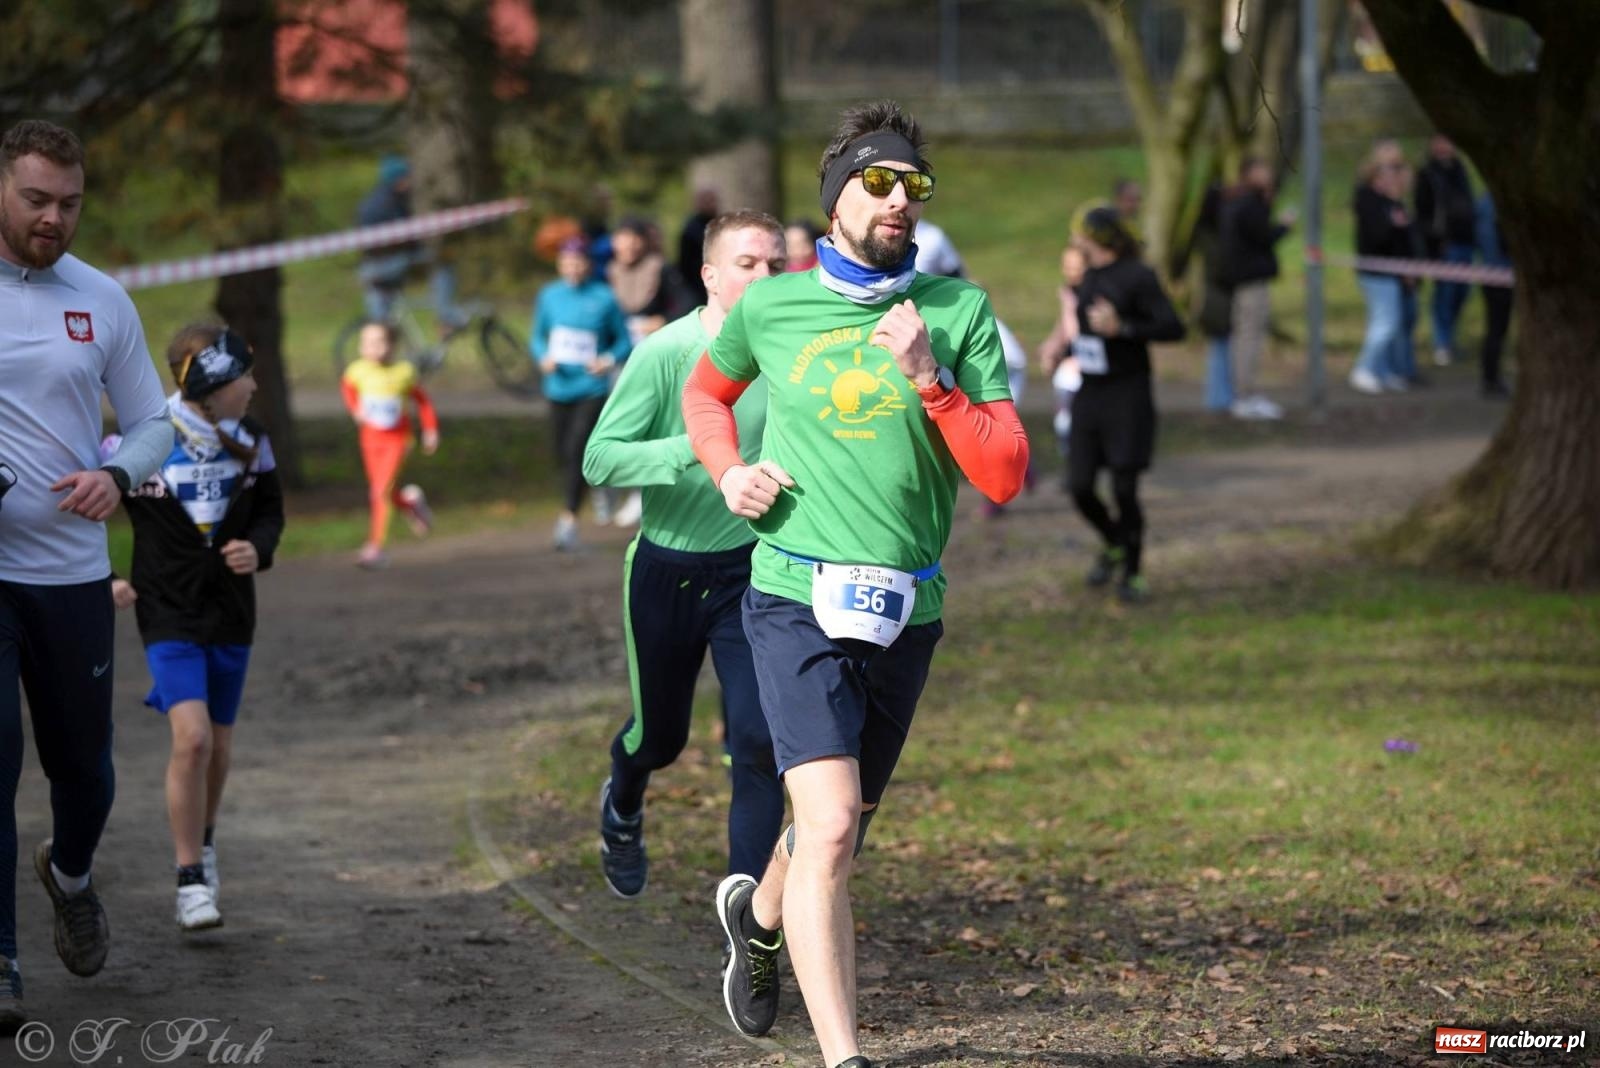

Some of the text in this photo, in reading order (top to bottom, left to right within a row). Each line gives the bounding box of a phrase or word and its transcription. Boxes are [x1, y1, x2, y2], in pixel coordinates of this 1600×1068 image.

[788, 327, 862, 384] NADMORSKA
[197, 482, 222, 501] 58
[865, 573, 893, 585] WILCZYM
[853, 585, 886, 614] 56
